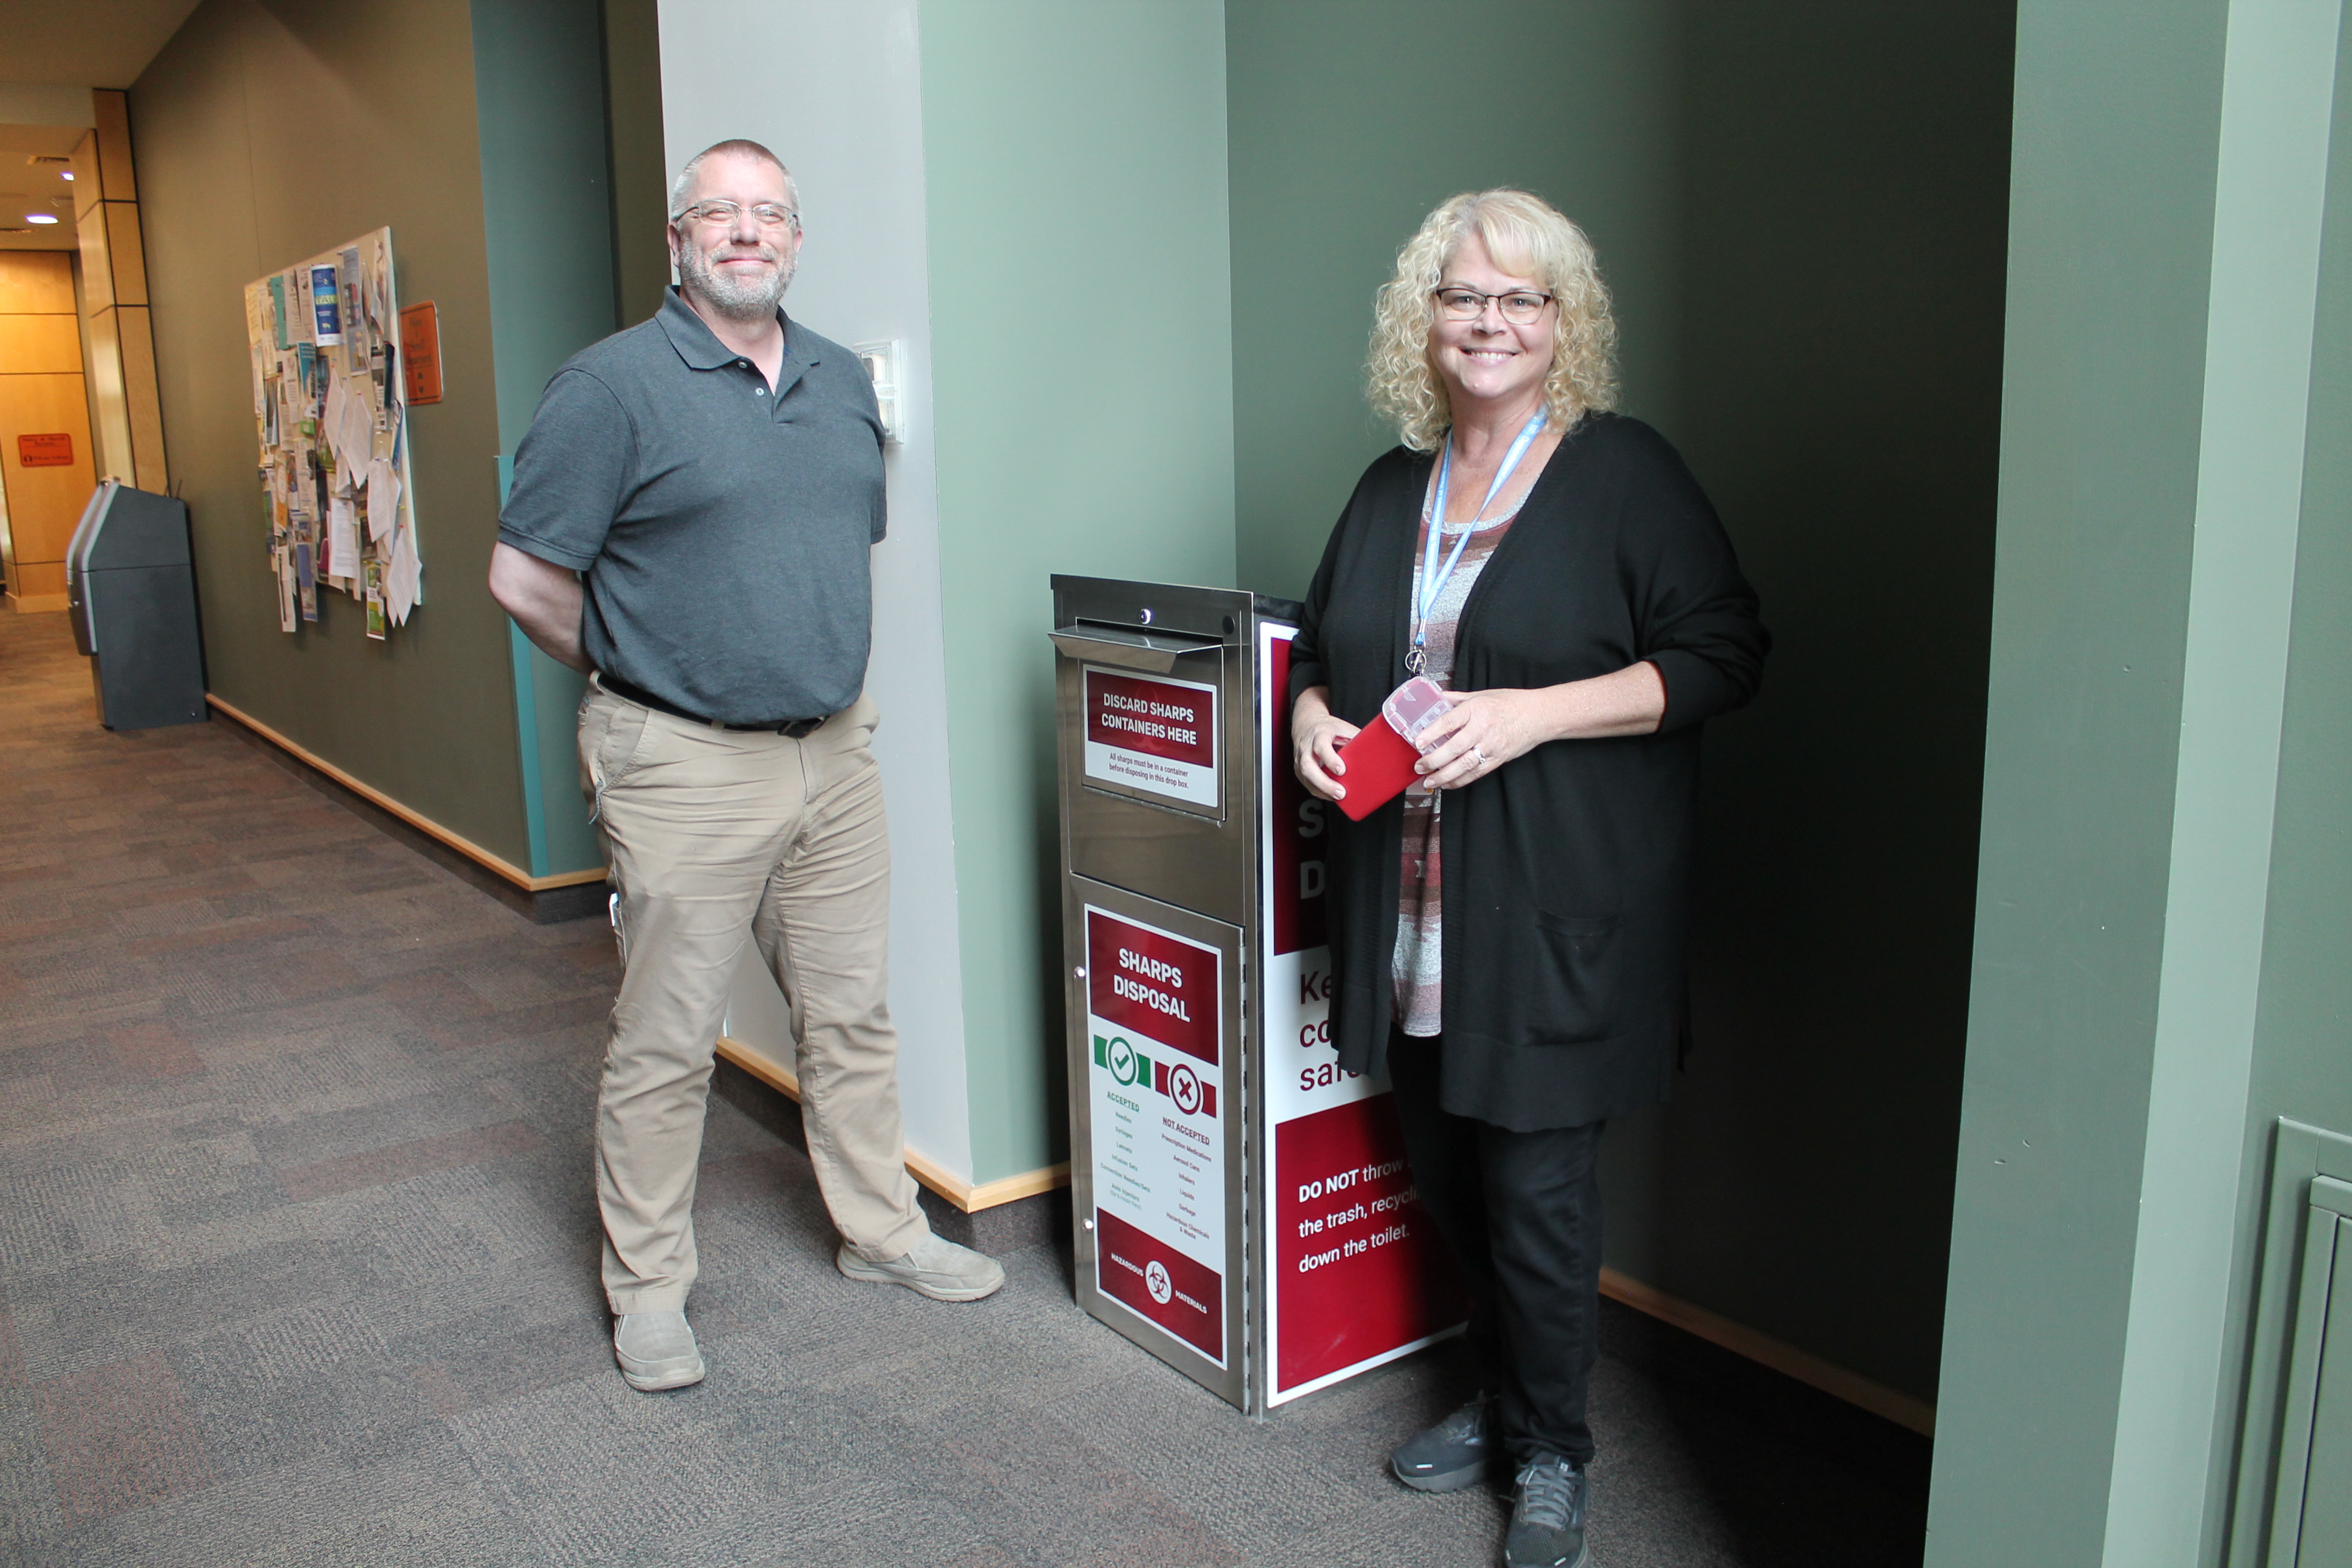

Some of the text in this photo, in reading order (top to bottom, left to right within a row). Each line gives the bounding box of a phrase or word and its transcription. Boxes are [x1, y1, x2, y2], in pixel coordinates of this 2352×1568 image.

[1500, 435, 1530, 478] Department
[1431, 496, 1443, 530] Department
[1427, 542, 1436, 566] County,
[1423, 566, 1433, 592] Douglas
[1104, 693, 1194, 723] DISCARD SHARPS
[1102, 714, 1197, 745] CONTAINERS HERE
[1109, 763, 1189, 788] before disposing in this drop box.
[1117, 755, 1133, 765] sharps
[1134, 759, 1146, 767] must
[1147, 761, 1153, 769] be
[1164, 766, 1188, 777] container
[1119, 948, 1183, 988] SHARPS
[1114, 974, 1190, 1022] DISPOSAL
[1301, 971, 1331, 1004] Ke
[1107, 1091, 1140, 1112] ACCEPTED
[1115, 1111, 1131, 1124] Needles
[1115, 1126, 1133, 1139] Syringes
[1163, 1117, 1210, 1145] NOT ACCEPTED
[1117, 1141, 1133, 1154] Lancets
[1162, 1134, 1212, 1162] Prescription Medications
[1112, 1154, 1138, 1172] Infusion Sets
[1173, 1155, 1200, 1172] Aerosol Cans
[1101, 1163, 1151, 1193] Connection Needles/Sets
[1179, 1173, 1195, 1185] Inhalers
[1299, 1158, 1403, 1203] DO NOT throw
[1112, 1183, 1140, 1202] Auto Injectors
[1180, 1189, 1194, 1201] Liquids
[1179, 1204, 1196, 1217] Garbage
[1298, 1186, 1419, 1238] the trash, recycli
[1166, 1212, 1210, 1239] Hazardous Chemicals
[1184, 1229, 1196, 1240] Waste
[1298, 1224, 1409, 1273] down the toilet.
[1111, 1253, 1144, 1277] HAZARDOUS
[1175, 1290, 1207, 1314] MATERIALS
